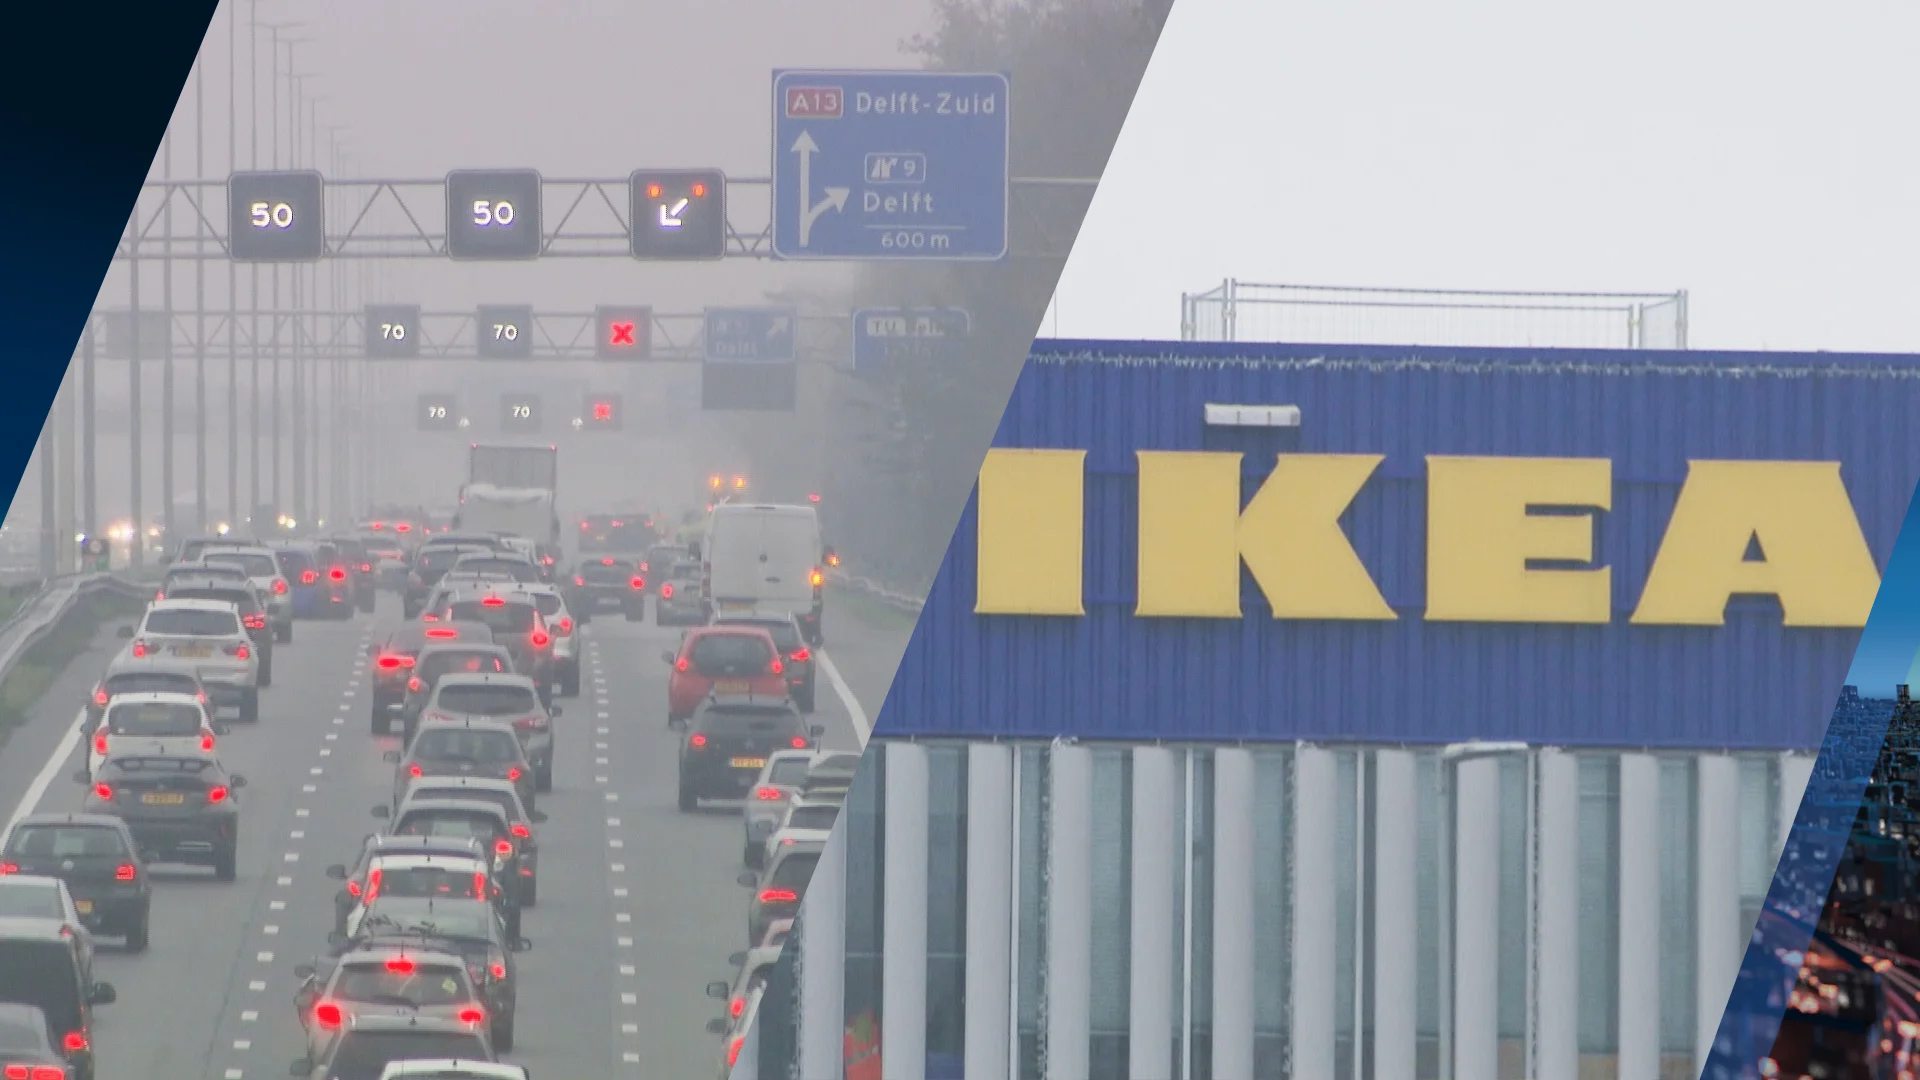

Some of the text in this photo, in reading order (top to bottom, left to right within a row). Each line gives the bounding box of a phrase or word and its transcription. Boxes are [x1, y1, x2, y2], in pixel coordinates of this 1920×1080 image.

[792, 92, 996, 115] A13 Delft-Zuid
[903, 159, 917, 177] 9
[863, 191, 934, 213] Delft
[250, 202, 294, 228] 50
[472, 200, 516, 226] 50
[881, 231, 950, 248] 600 m
[381, 323, 406, 340] 70
[493, 324, 518, 341] 70
[428, 406, 447, 418] 70
[512, 406, 531, 418] 70
[974, 447, 1880, 627] IKEA
